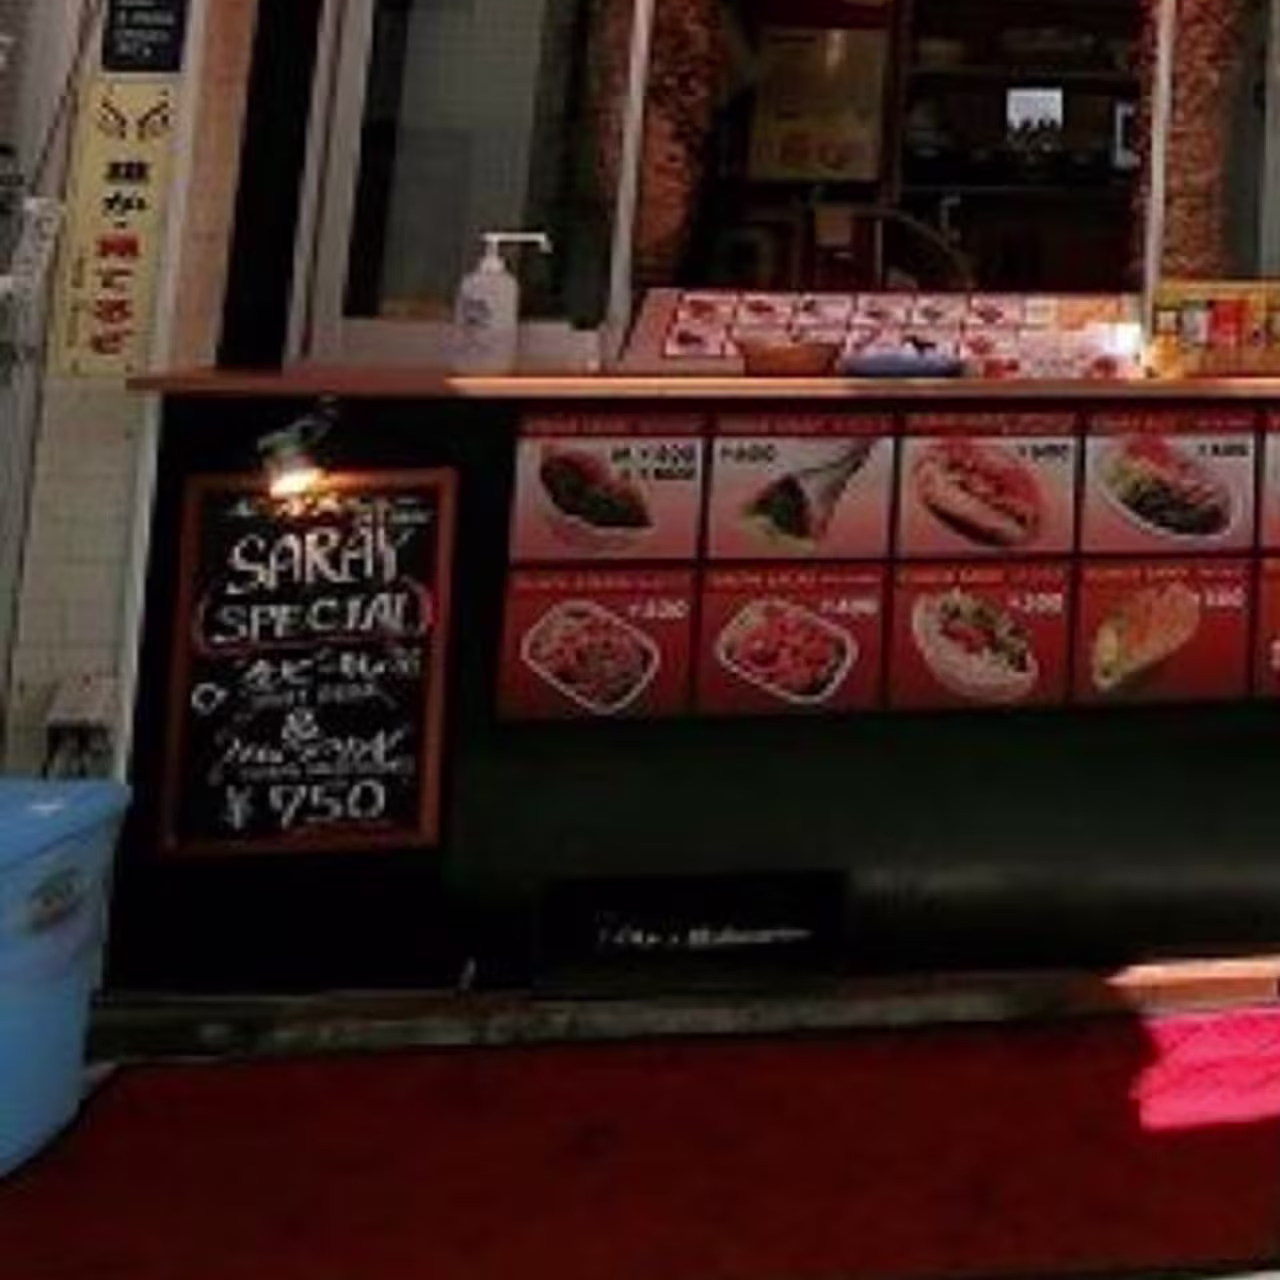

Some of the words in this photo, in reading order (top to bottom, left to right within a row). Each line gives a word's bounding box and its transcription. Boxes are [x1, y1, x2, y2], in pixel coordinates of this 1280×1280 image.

[223, 521, 414, 596] SARAY
[212, 590, 412, 645] SPECIAL
[221, 778, 388, 832] ¥750
